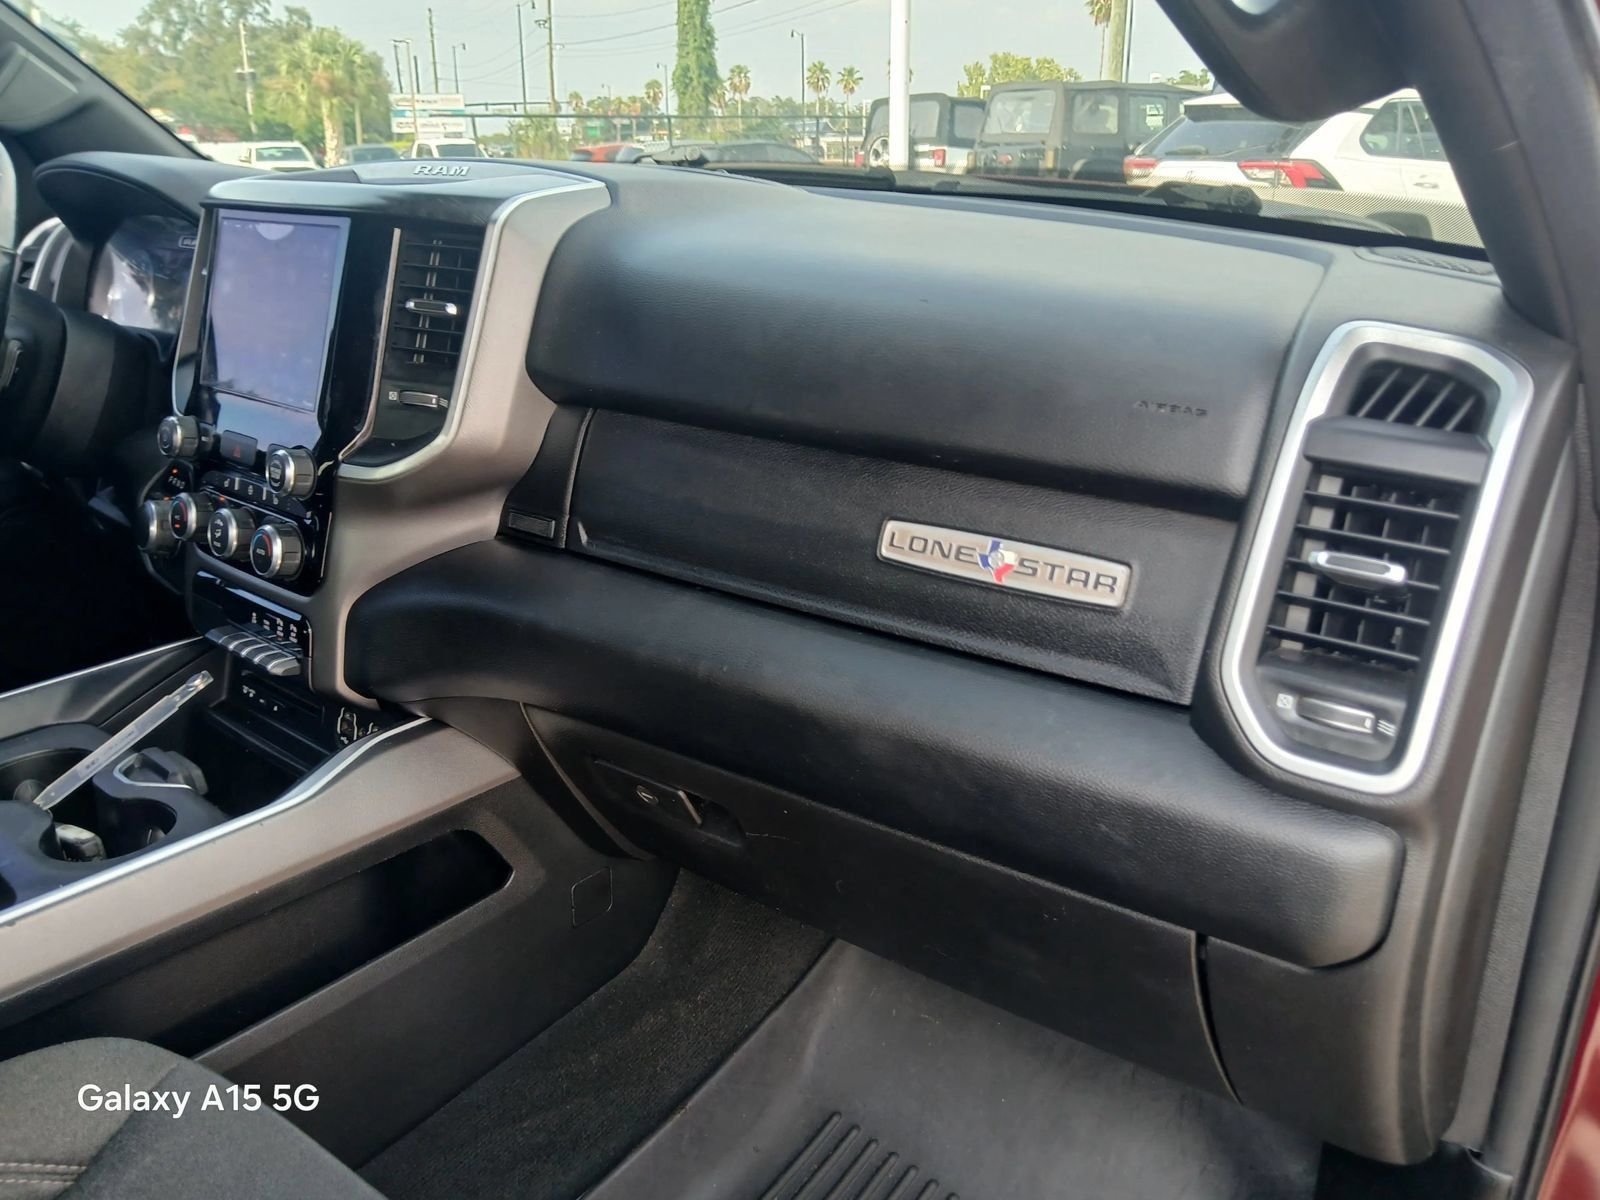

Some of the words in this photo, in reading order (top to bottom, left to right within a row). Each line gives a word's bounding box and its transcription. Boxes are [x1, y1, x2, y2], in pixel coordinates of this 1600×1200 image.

[412, 163, 471, 177] RAM
[888, 530, 981, 565] LONE
[1013, 556, 1119, 594] STAR
